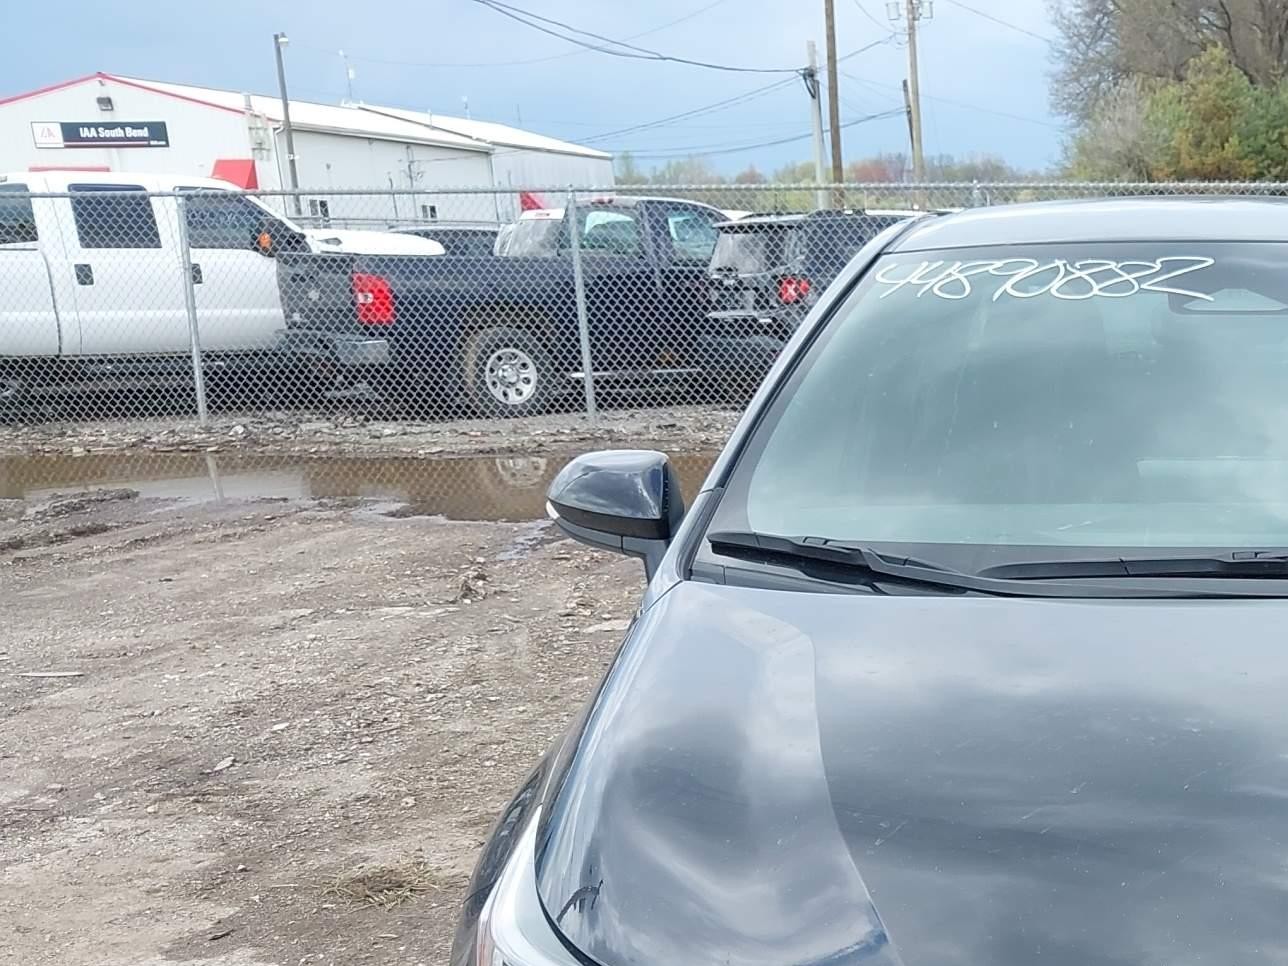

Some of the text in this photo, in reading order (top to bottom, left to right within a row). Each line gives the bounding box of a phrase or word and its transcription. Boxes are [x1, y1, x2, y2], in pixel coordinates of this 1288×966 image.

[79, 126, 150, 138] IAA South Bend
[875, 256, 1215, 302] 44890882
